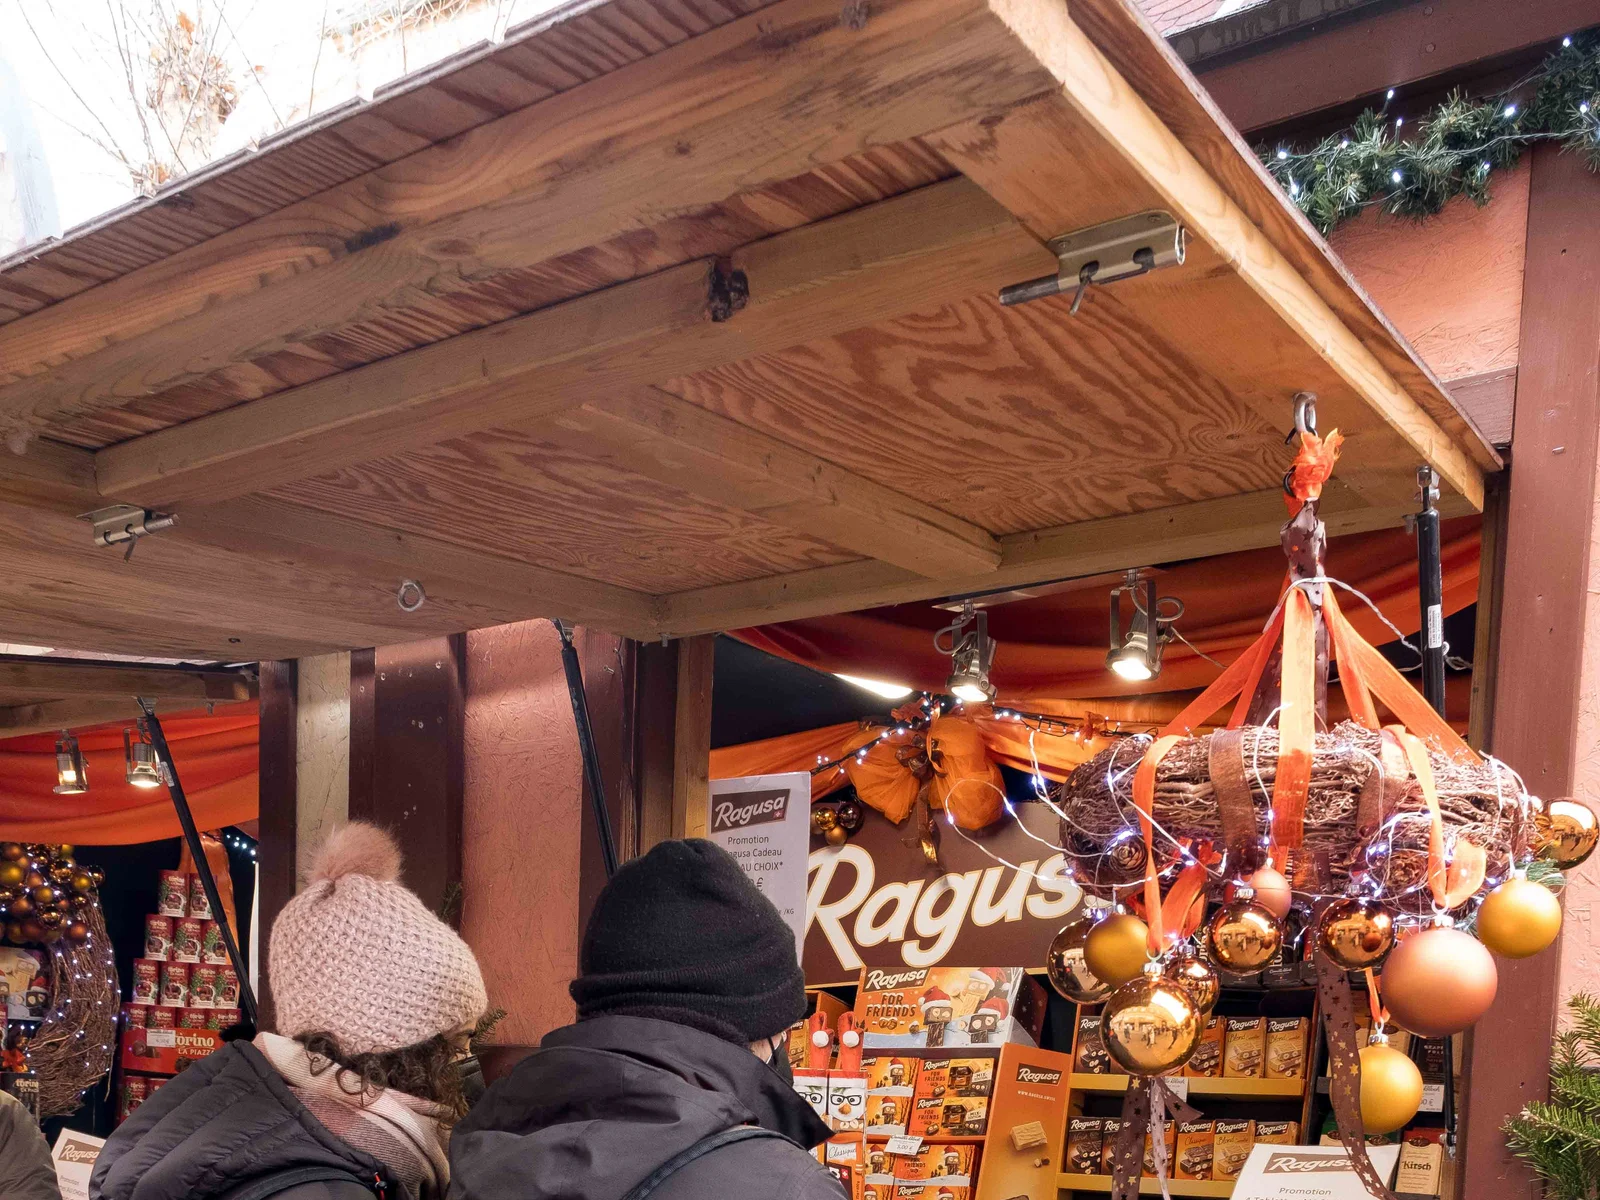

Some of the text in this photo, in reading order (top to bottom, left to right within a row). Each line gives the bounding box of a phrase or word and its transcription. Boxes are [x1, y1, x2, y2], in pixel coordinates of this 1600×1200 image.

[714, 796, 786, 828] Ragusa
[727, 835, 770, 845] Promotion
[726, 848, 782, 860] agusa Cadeau
[803, 843, 1098, 971] Ragus
[865, 969, 928, 990] Ragusa
[881, 992, 904, 1005] FOR
[865, 1004, 917, 1017] FRIENDS
[1228, 1019, 1260, 1031] Ragusa
[1268, 1020, 1300, 1032] Ragusa
[1018, 1068, 1060, 1083] Ragusa
[1071, 1119, 1100, 1130] Ragusa
[1180, 1121, 1213, 1133] Ragusa
[1216, 1121, 1248, 1133] Ragusa
[1255, 1122, 1288, 1136] Ragusa
[1279, 1187, 1332, 1196] Promotion
